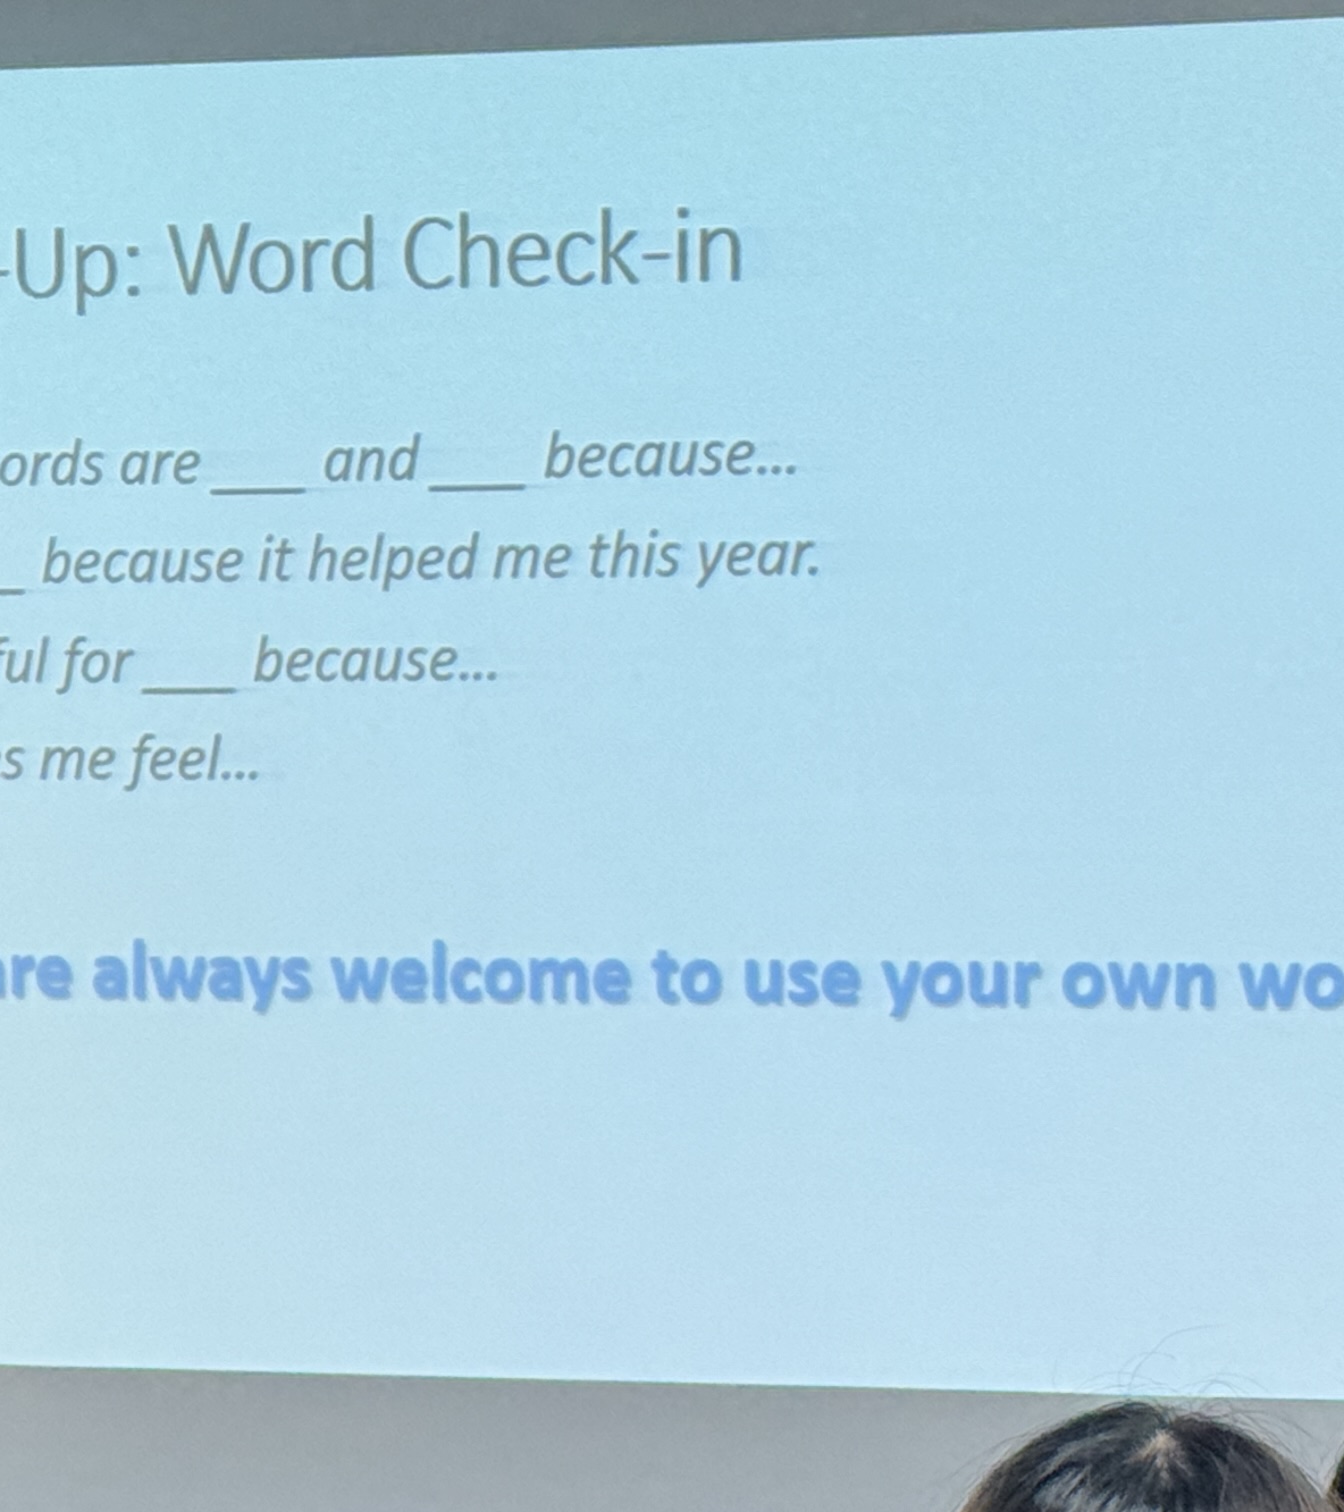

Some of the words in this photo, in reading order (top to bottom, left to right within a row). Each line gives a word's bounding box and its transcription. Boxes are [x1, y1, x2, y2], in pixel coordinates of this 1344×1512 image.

[168, 215, 376, 297] Word
[405, 207, 743, 292] Check-in
[121, 451, 203, 488] are
[325, 433, 423, 484] and
[545, 430, 798, 481] because...
[43, 537, 245, 586] because
[259, 534, 297, 584] it
[309, 531, 481, 595] helped
[494, 544, 574, 582] me
[590, 529, 683, 581] this
[697, 541, 821, 590] year.
[55, 636, 137, 697] for
[254, 635, 498, 686] because...
[40, 746, 118, 783] me
[124, 733, 259, 793] feel...
[93, 939, 315, 1018] always
[331, 940, 635, 1008] welcome
[651, 950, 725, 1009] to
[746, 960, 864, 1011] use
[882, 961, 1046, 1031] your
[1063, 962, 1218, 1013] own
